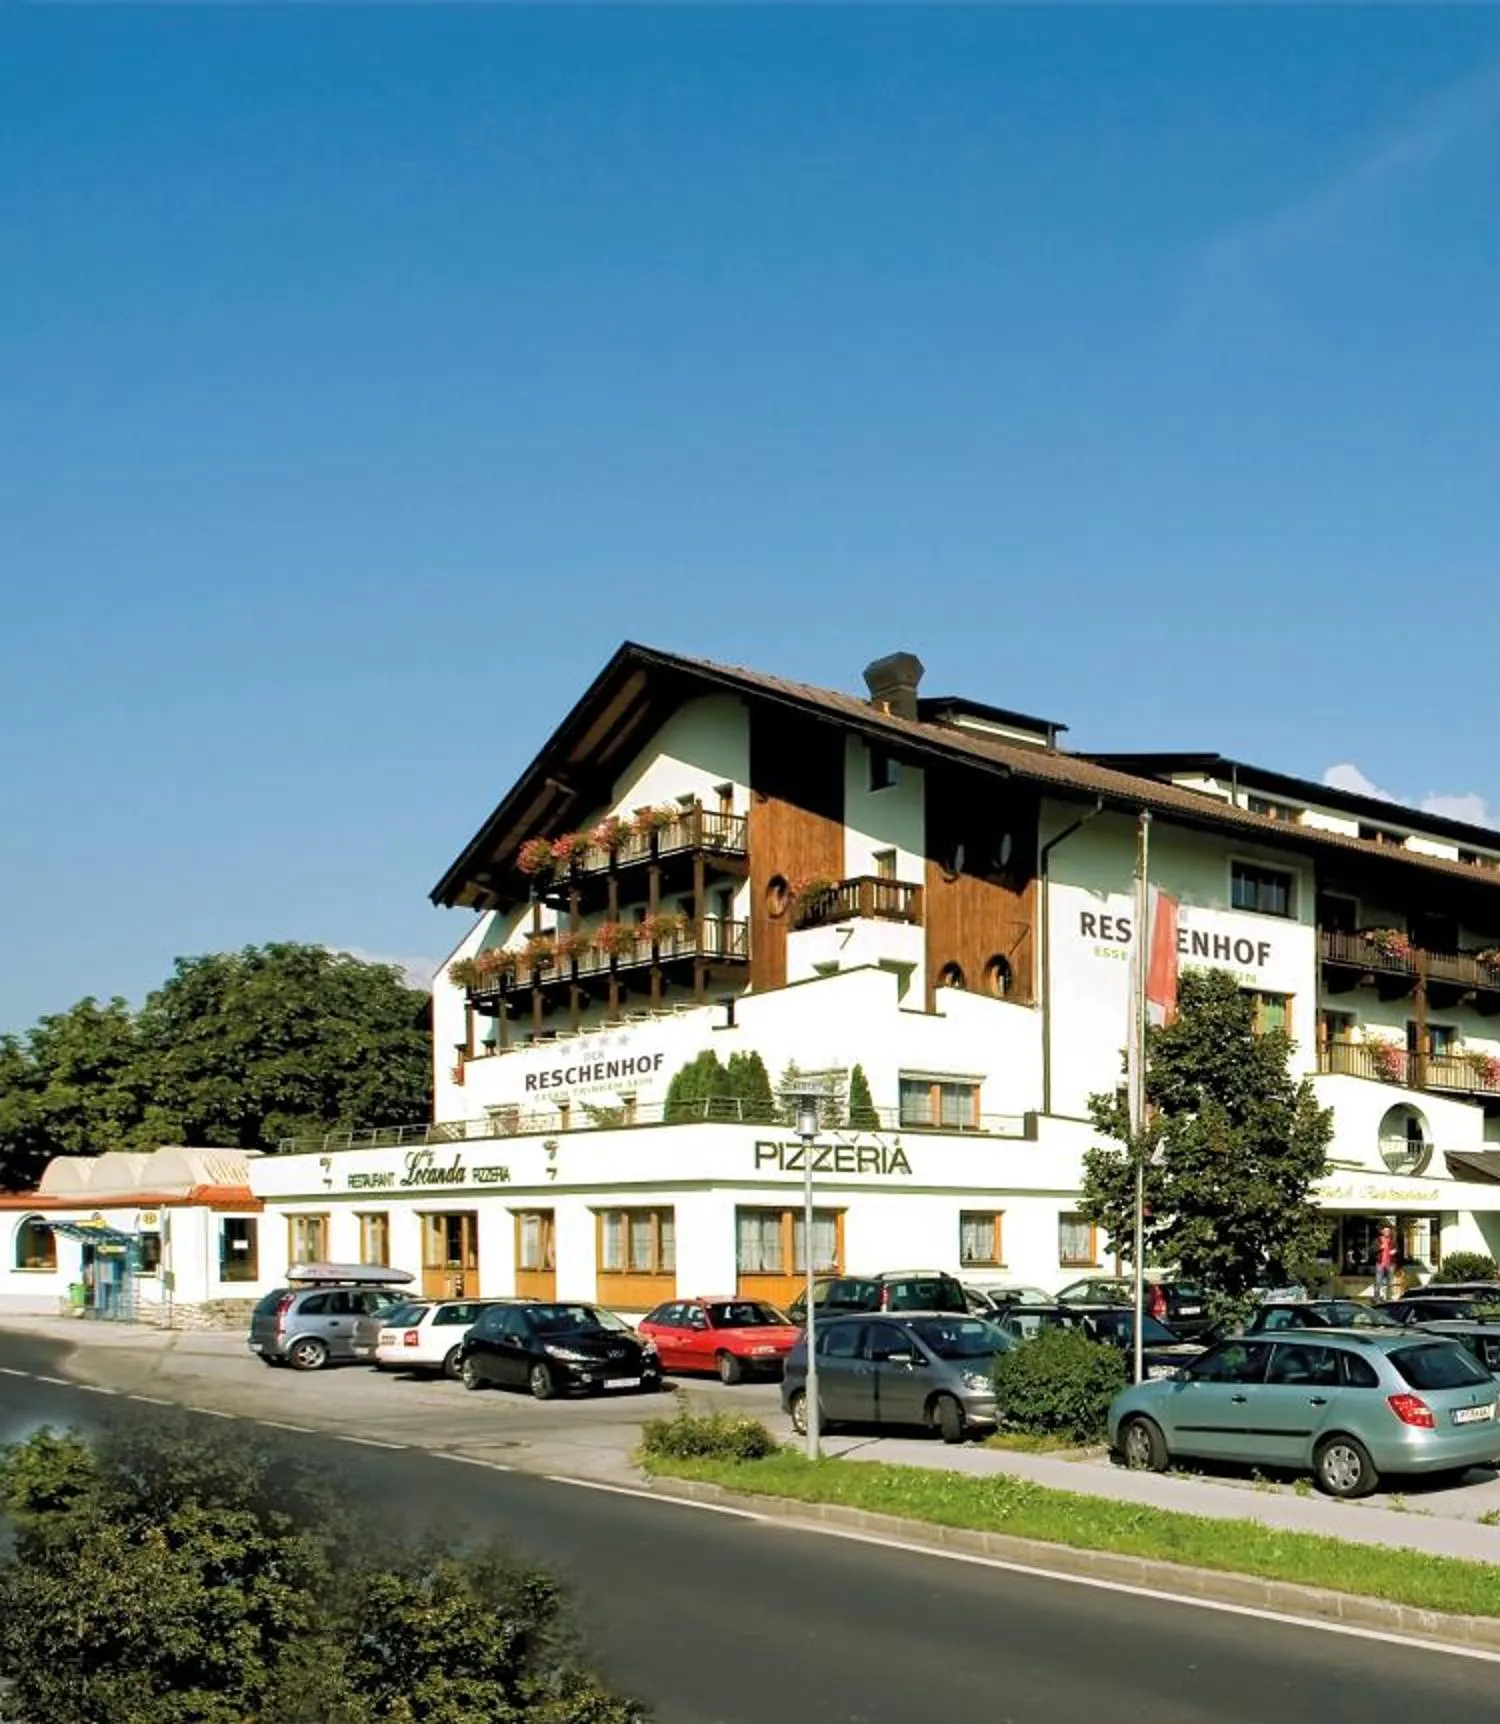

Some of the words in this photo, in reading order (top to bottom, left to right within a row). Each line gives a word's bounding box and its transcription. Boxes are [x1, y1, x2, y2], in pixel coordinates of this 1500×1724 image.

[1079, 911, 1272, 967] RESENHOF
[525, 1053, 665, 1092] RESCHENHOF
[400, 1149, 467, 1187] Locanda
[472, 1166, 511, 1183] PIZZERIA
[755, 1140, 913, 1175] PIZZERIA
